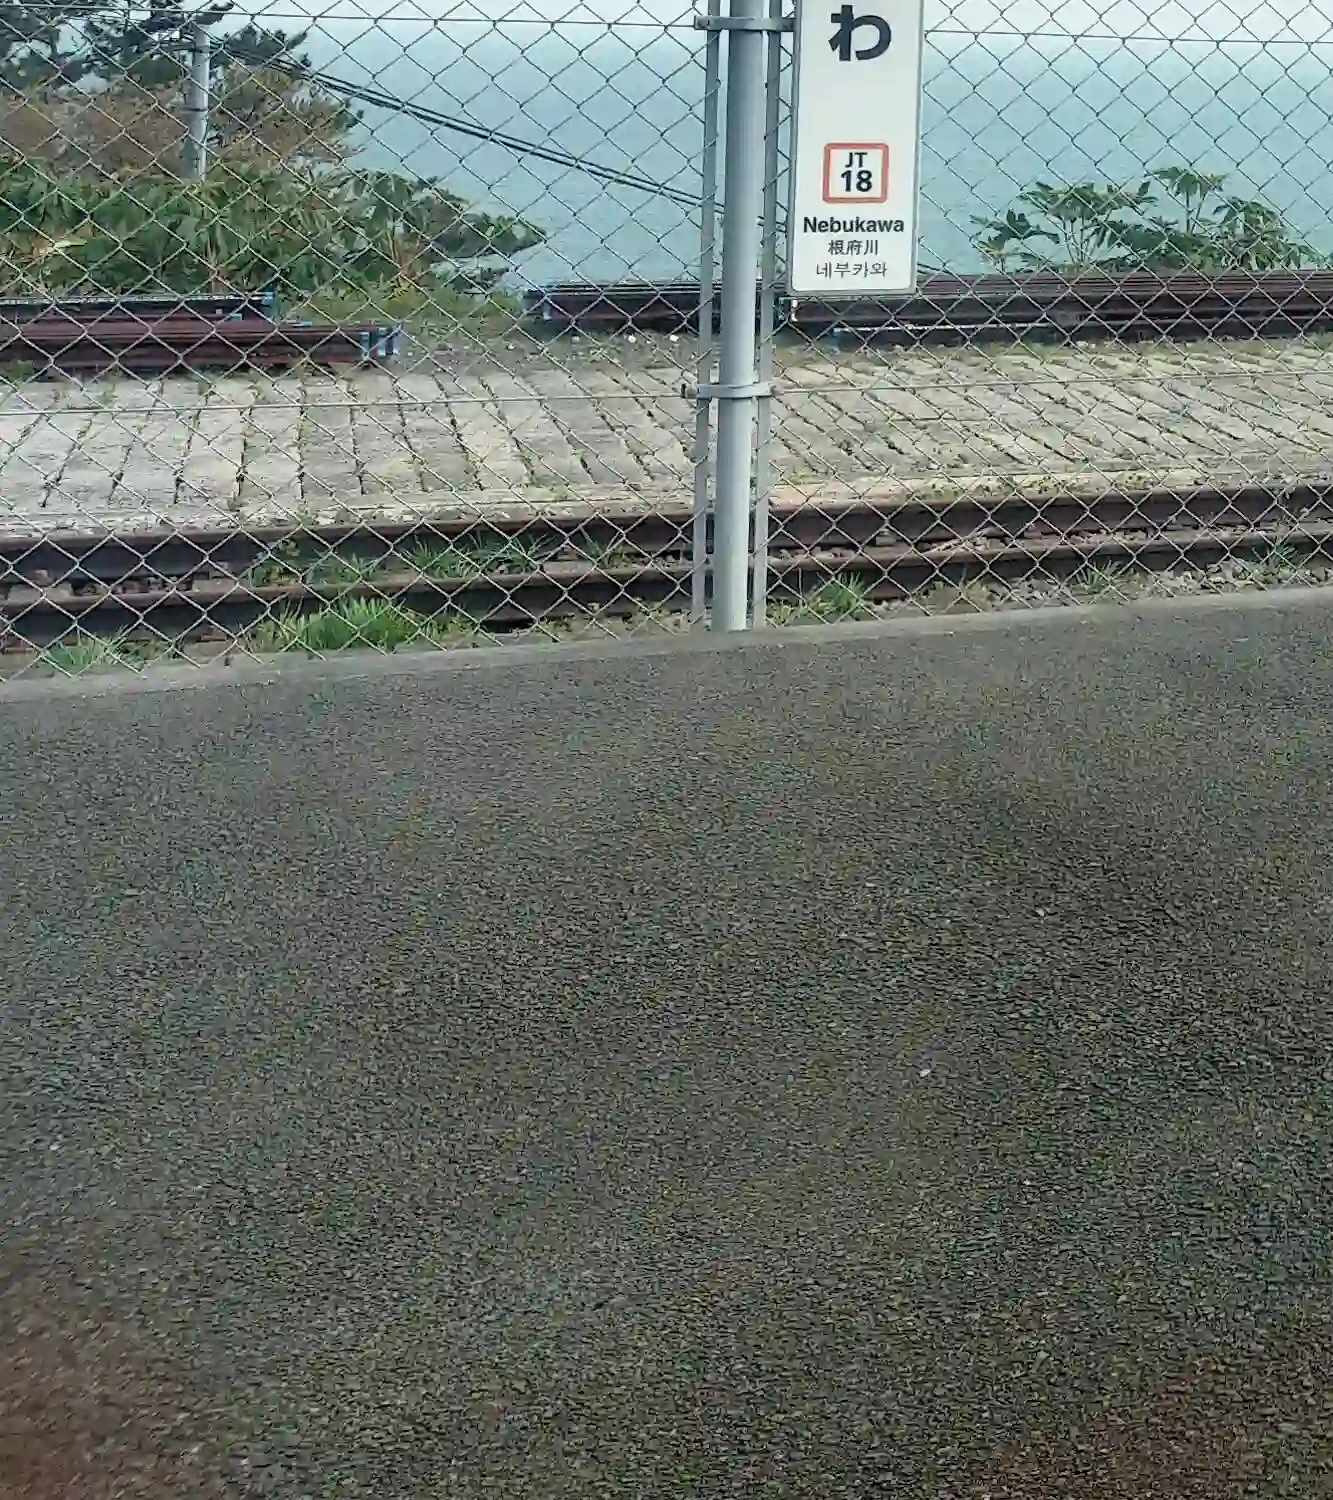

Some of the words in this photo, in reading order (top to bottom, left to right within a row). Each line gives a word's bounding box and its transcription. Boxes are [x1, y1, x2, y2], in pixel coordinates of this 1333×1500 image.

[845, 152, 868, 168] JT
[840, 170, 873, 192] 18
[803, 216, 905, 233] Nebukawa
[828, 239, 879, 256] 根府川
[816, 261, 888, 279] 네부카와
